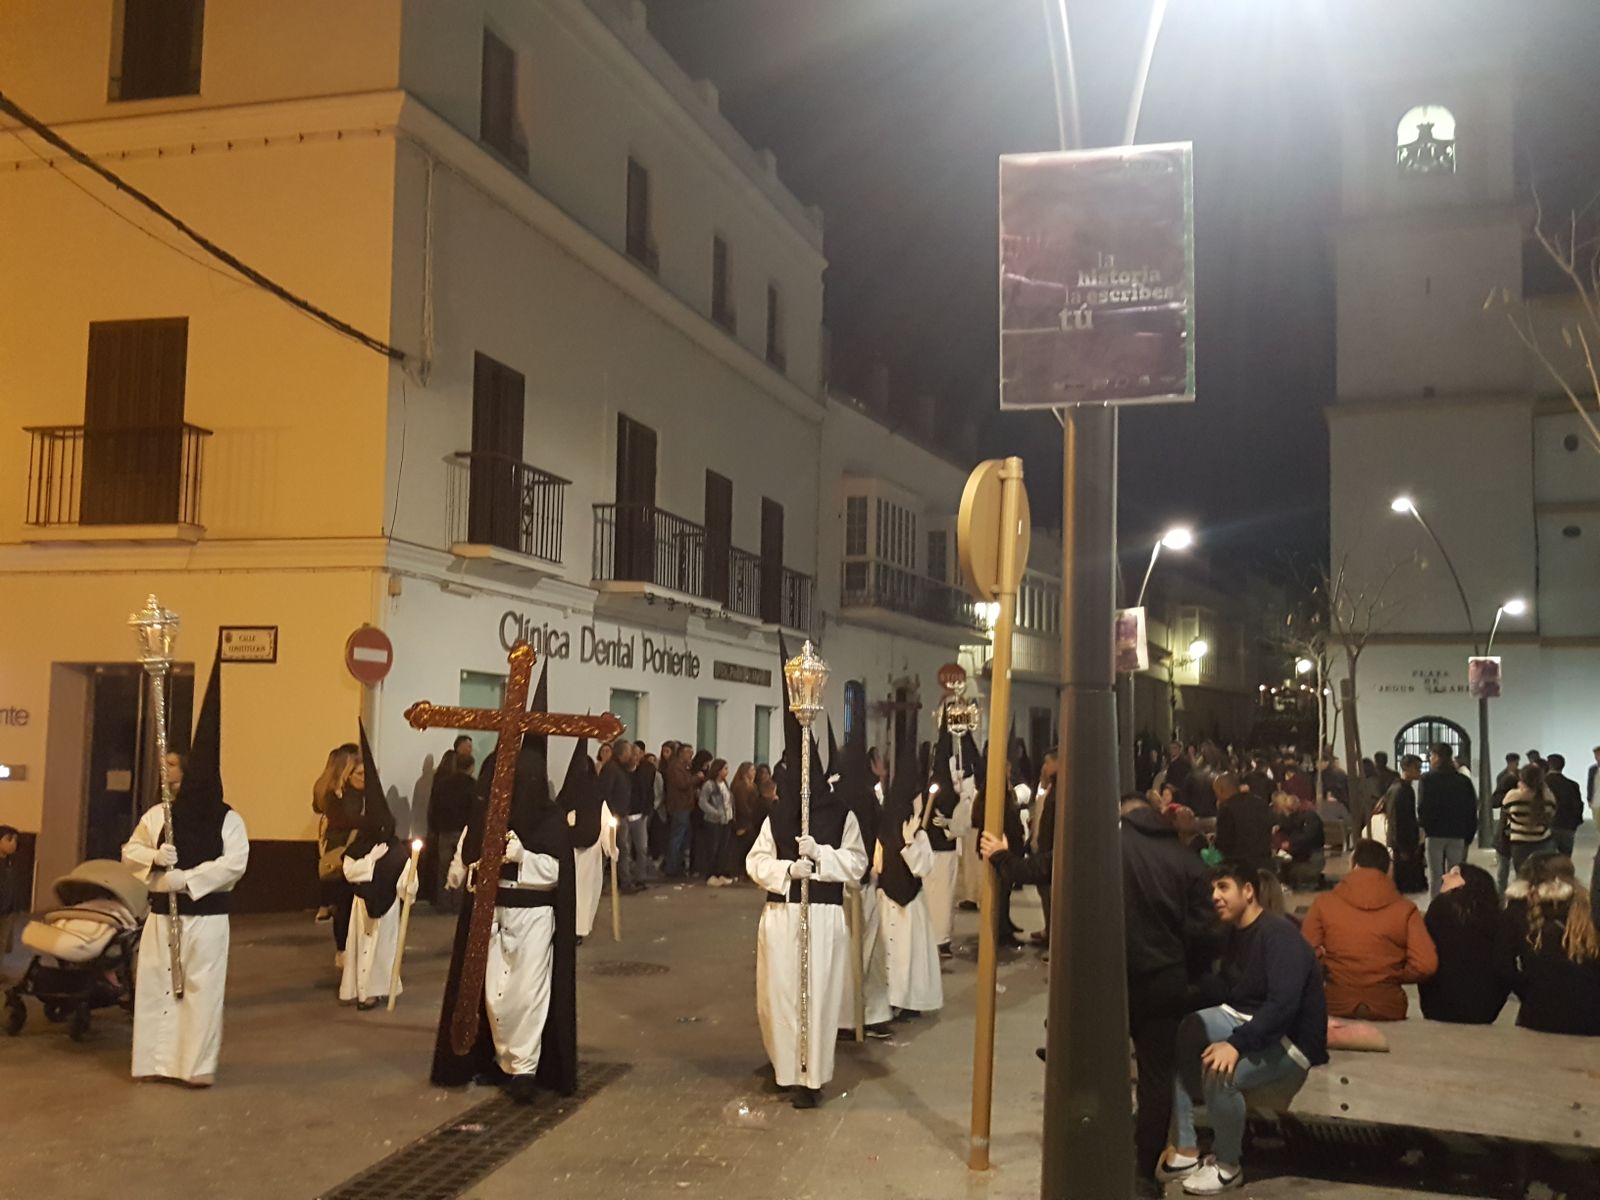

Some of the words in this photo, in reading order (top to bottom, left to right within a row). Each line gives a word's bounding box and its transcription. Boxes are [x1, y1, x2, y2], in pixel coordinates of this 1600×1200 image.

[1077, 264, 1161, 287] historia
[1086, 281, 1174, 303] escribes
[1058, 303, 1094, 331] tú
[580, 625, 634, 670] Dental
[642, 637, 701, 680] Poniente
